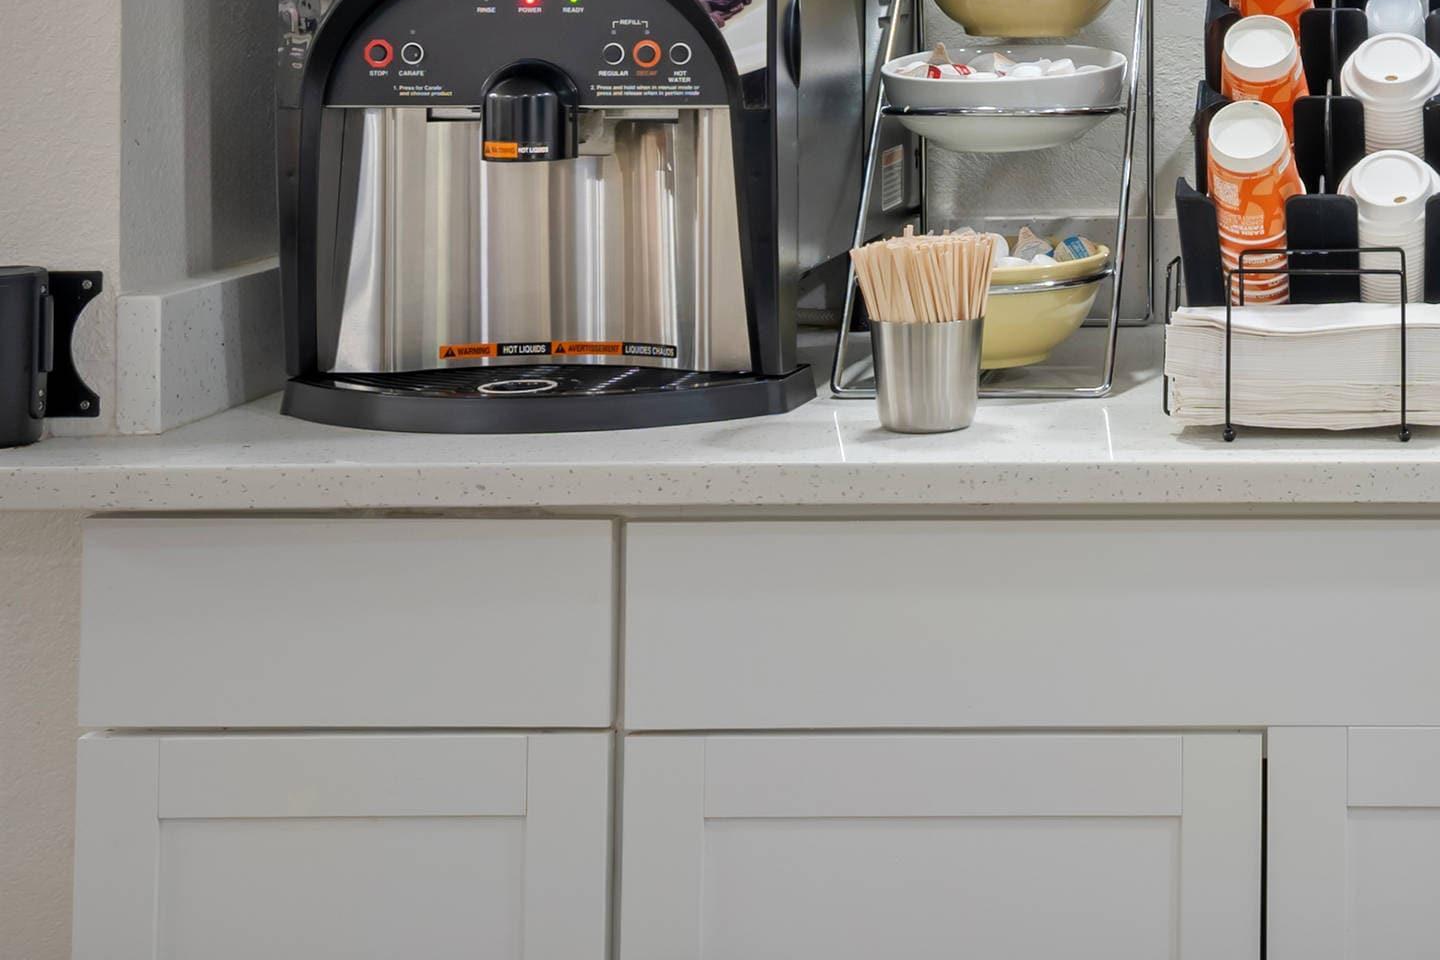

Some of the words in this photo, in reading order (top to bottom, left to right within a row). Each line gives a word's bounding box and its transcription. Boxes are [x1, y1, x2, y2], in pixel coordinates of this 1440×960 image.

[458, 345, 490, 356] WARNING
[503, 346, 518, 354] HOT
[519, 344, 546, 354] LIQUIDS
